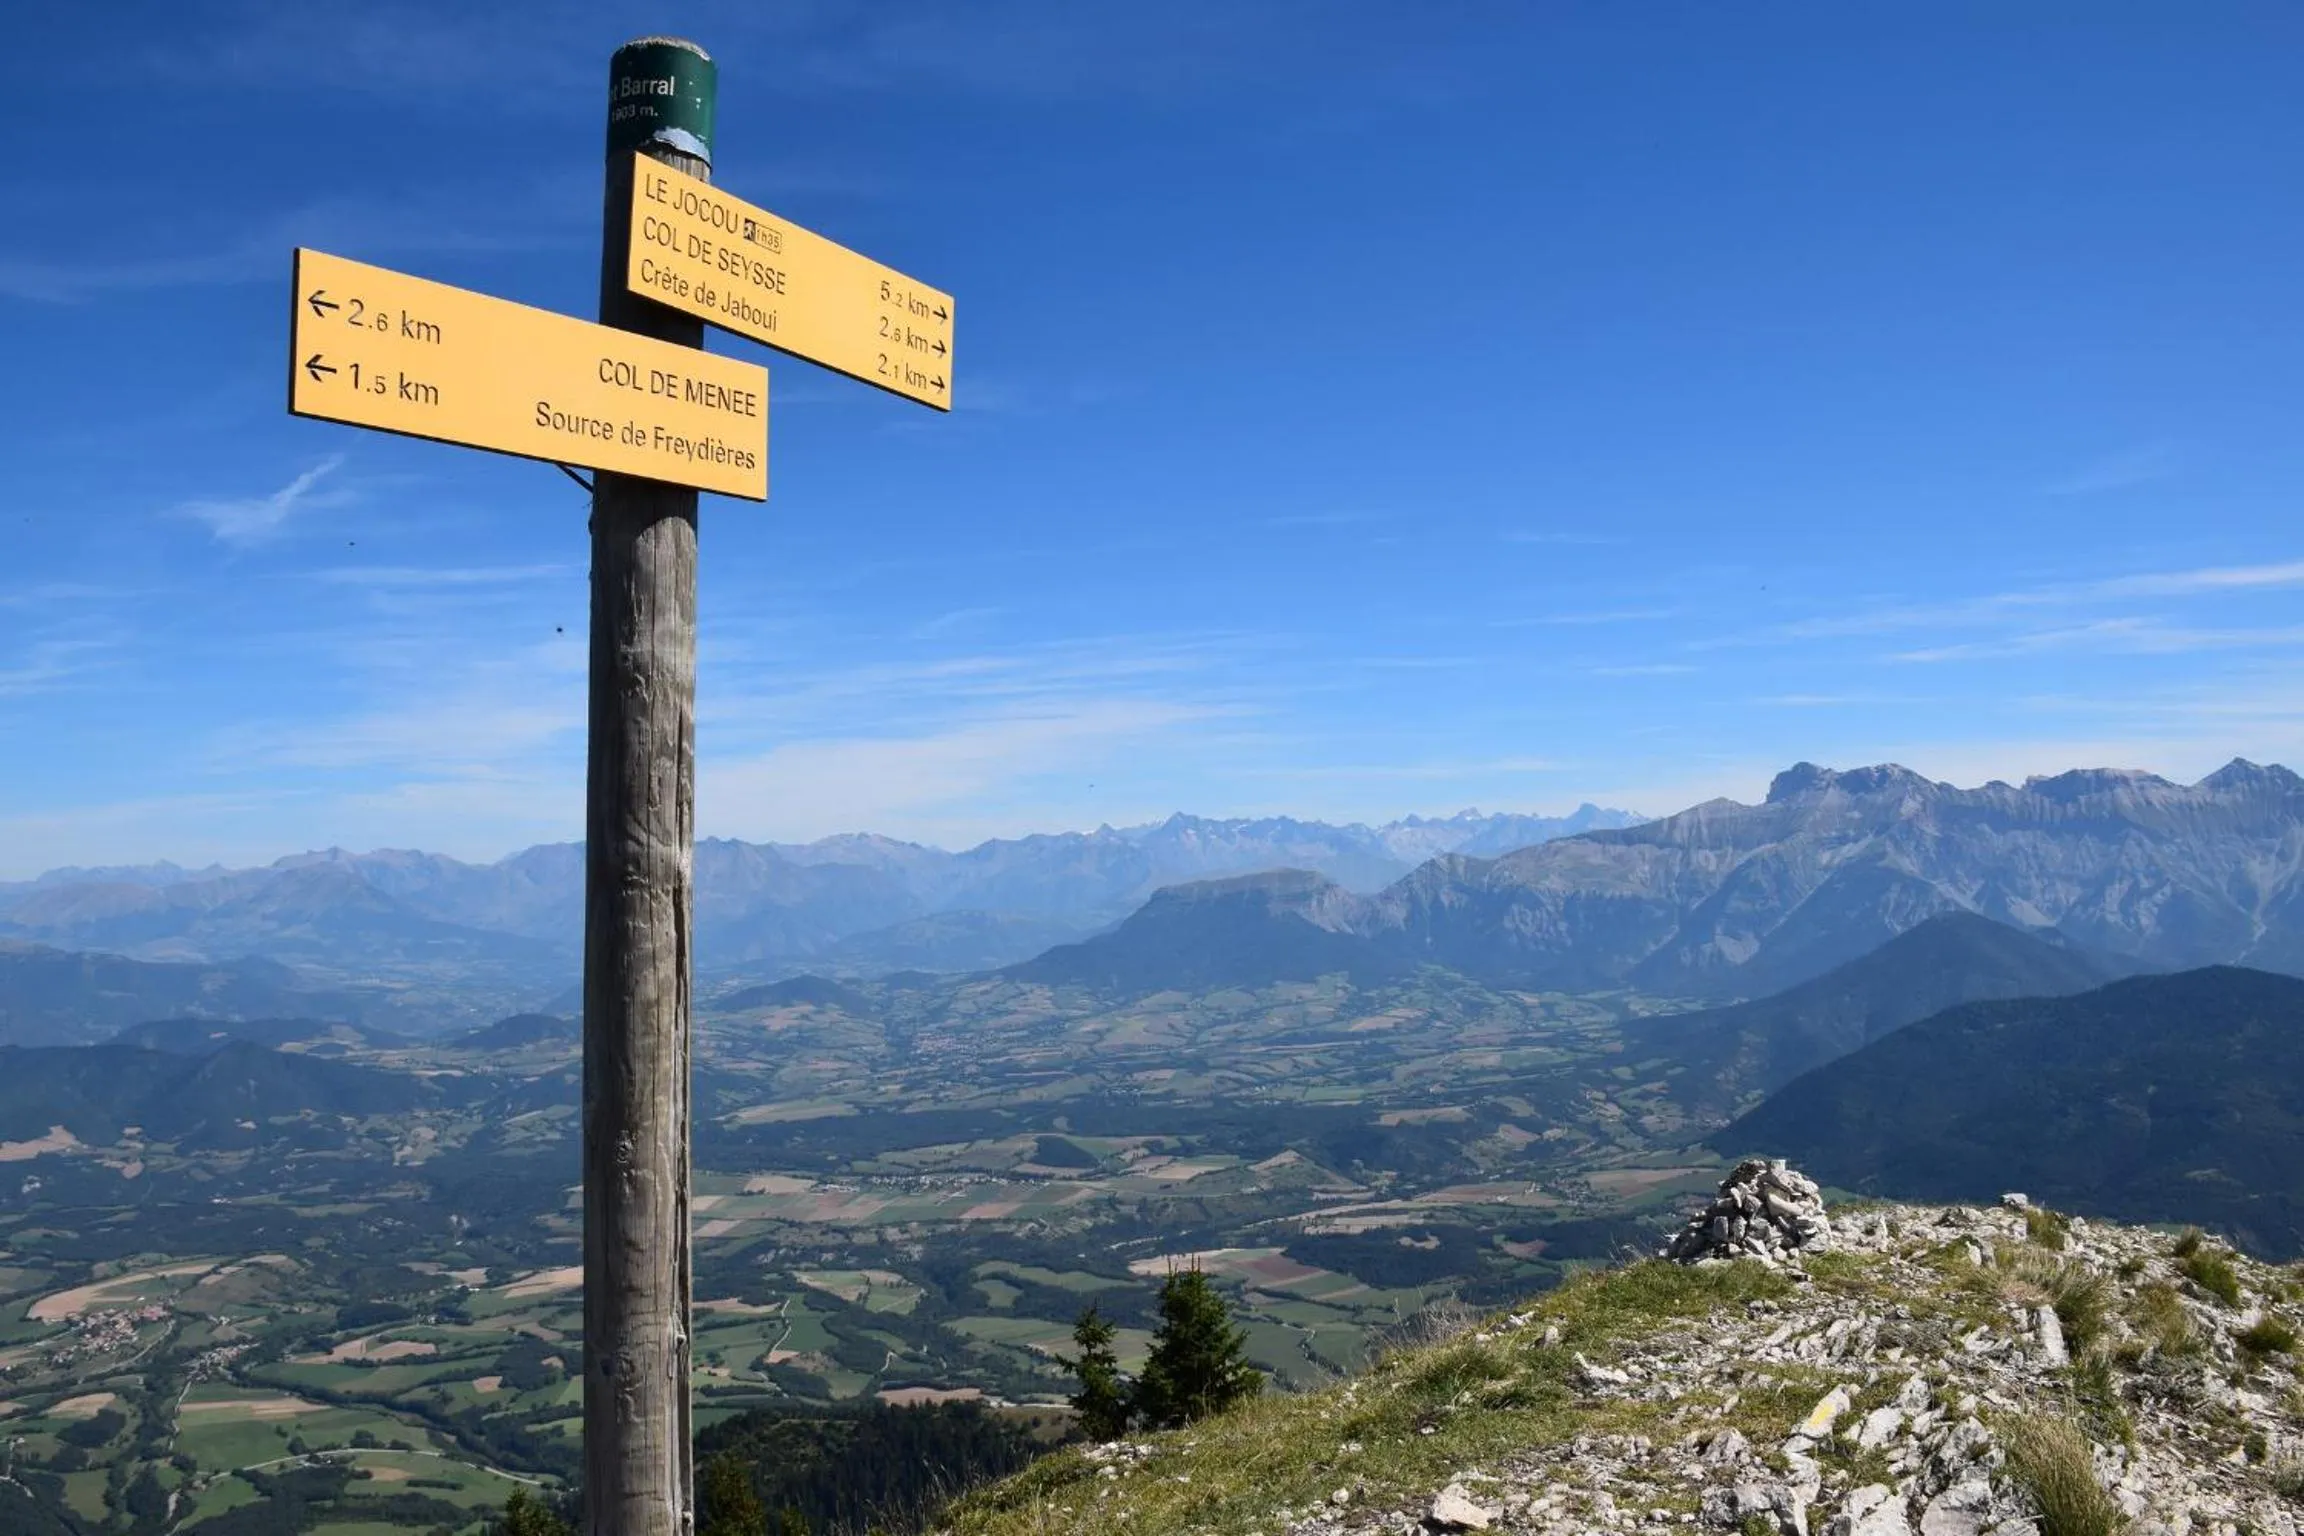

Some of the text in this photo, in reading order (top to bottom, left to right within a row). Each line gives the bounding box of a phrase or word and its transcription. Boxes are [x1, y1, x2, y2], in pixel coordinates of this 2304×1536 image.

[621, 76, 675, 97] Barral
[646, 173, 668, 204] LE
[672, 188, 739, 234] JOCOU
[643, 216, 786, 296] COL DE SEYSSE
[640, 258, 778, 333] Crête de Jaboui
[880, 280, 930, 320] 5.2 km
[347, 298, 441, 345] 2.6 km
[906, 326, 929, 354] km
[348, 362, 439, 406] 1.5 km
[598, 357, 757, 417] COL DE MENEE
[877, 353, 927, 390] 2.1 km
[535, 401, 757, 471] Source de Freydières
